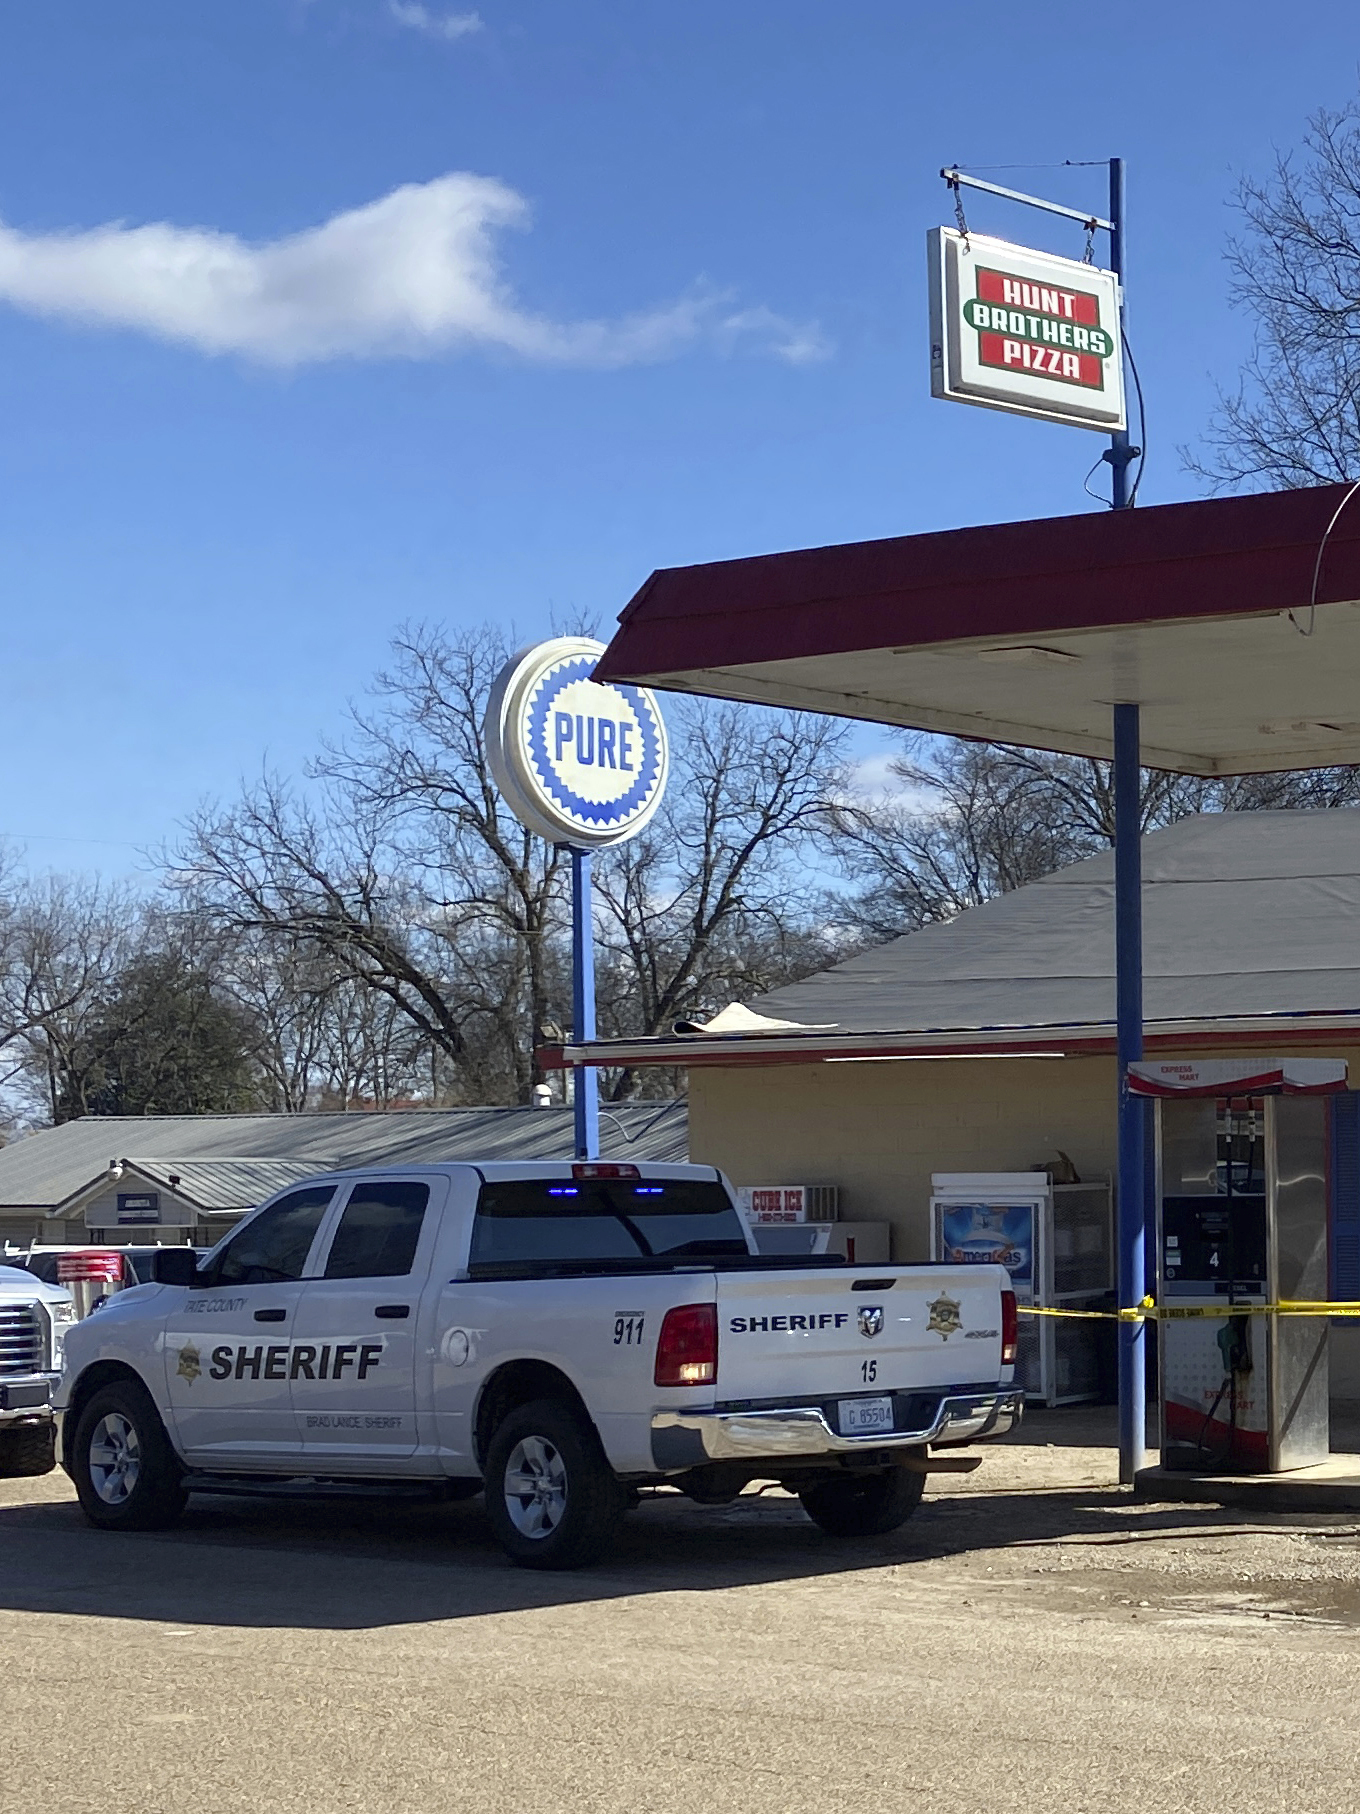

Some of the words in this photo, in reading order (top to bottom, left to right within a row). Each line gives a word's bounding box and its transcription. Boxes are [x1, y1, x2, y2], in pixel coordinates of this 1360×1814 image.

[1003, 278, 1076, 318] HUNT
[972, 303, 1106, 355] BROTHERS
[1003, 339, 1080, 380] PIZZA
[555, 711, 634, 771] PURE
[1161, 1065, 1192, 1073] EXPRESS
[1179, 1073, 1199, 1081] MART
[784, 1190, 802, 1211] ICE
[1209, 1252, 1219, 1267] 4
[183, 1299, 205, 1313] TATE
[206, 1297, 249, 1313] COUNTY
[613, 1318, 645, 1345] 911
[729, 1313, 849, 1333] SHERIFF
[209, 1344, 384, 1380] SHERIFF
[861, 1359, 878, 1383] 15
[306, 1416, 331, 1428] BRAD
[365, 1416, 403, 1428] SHERIFF
